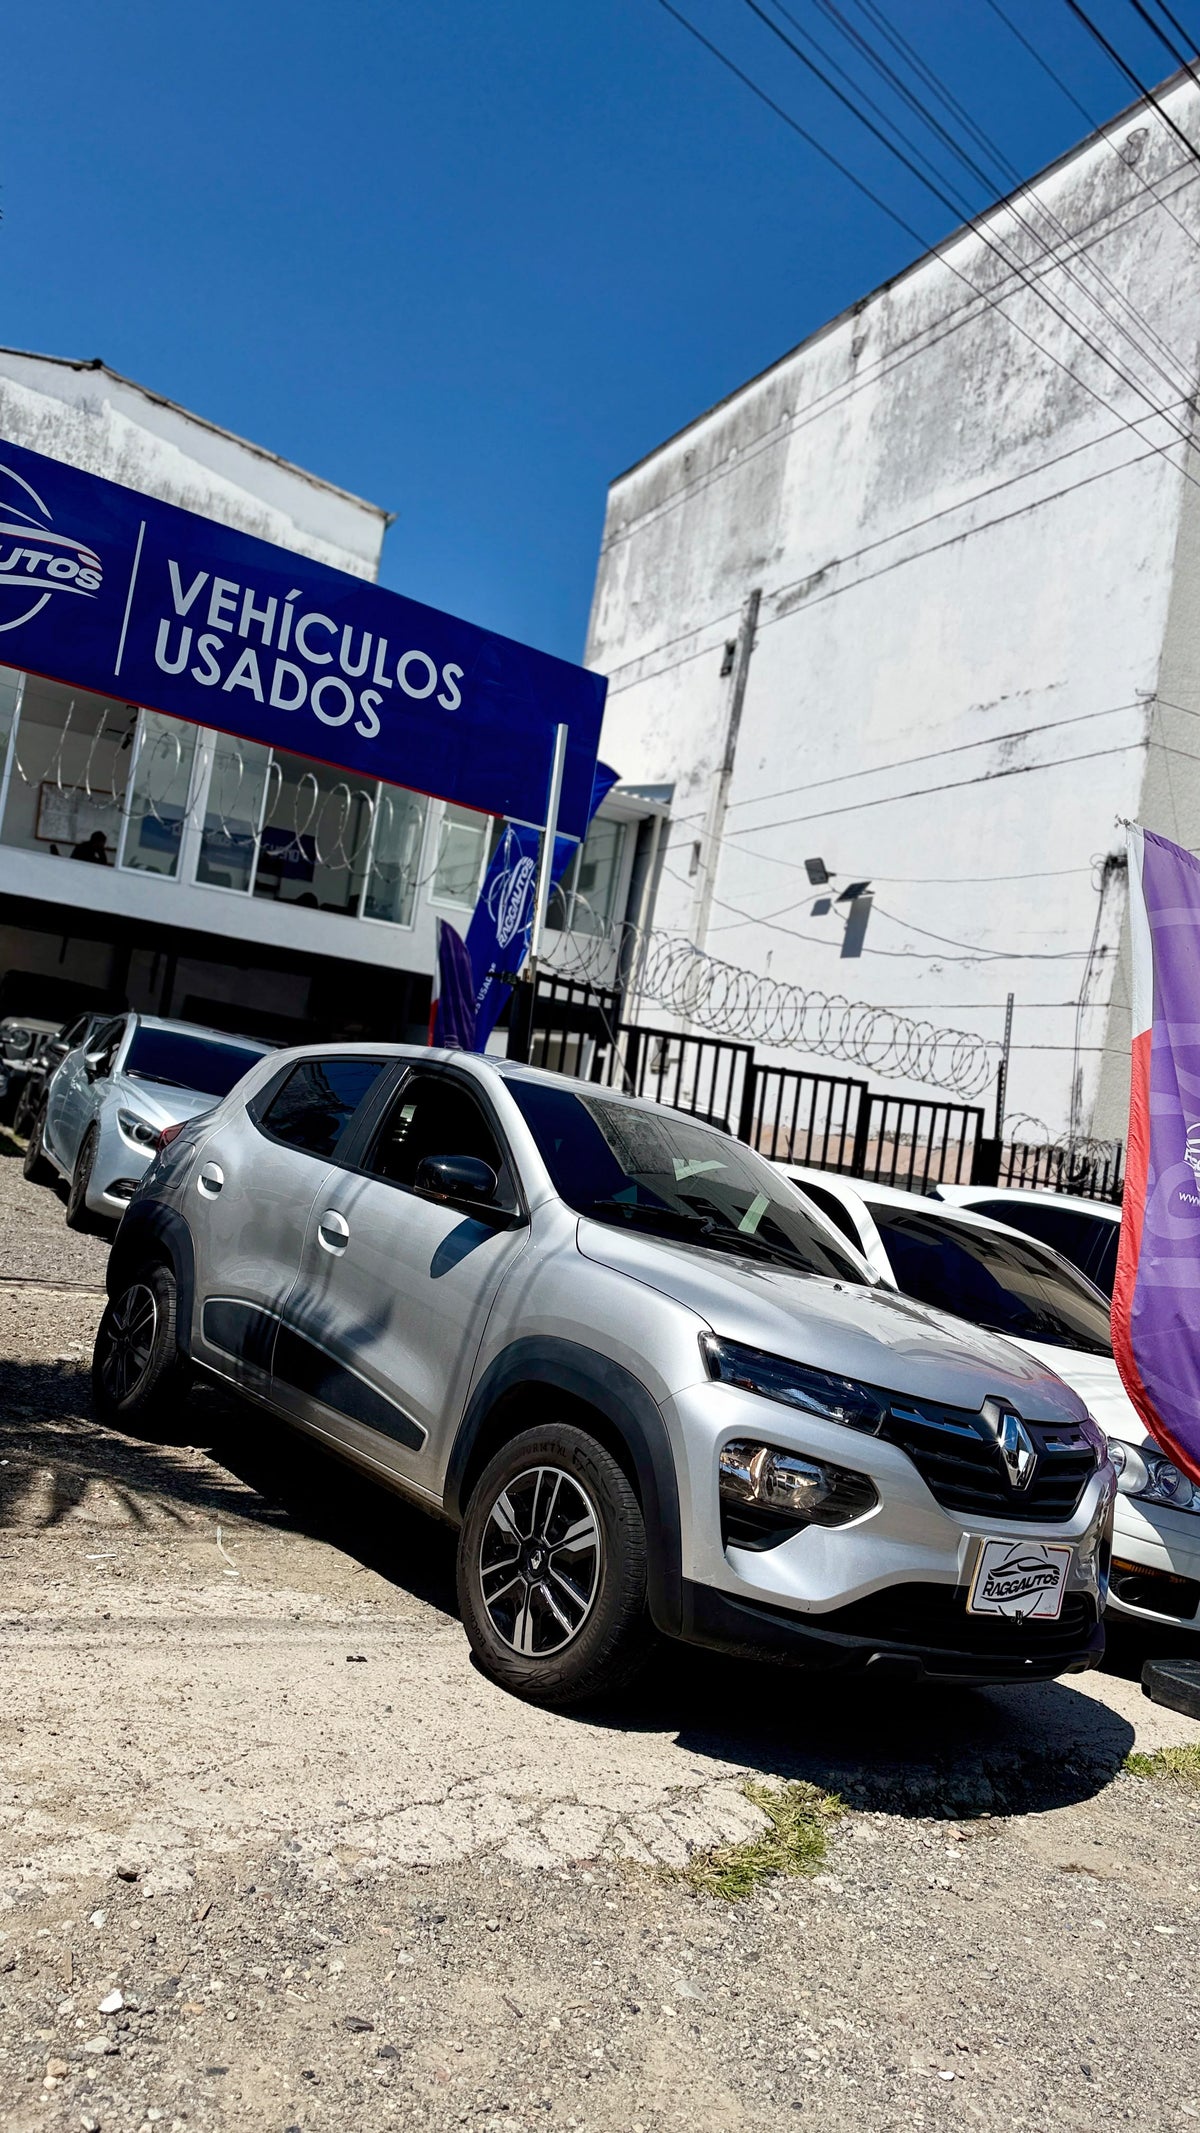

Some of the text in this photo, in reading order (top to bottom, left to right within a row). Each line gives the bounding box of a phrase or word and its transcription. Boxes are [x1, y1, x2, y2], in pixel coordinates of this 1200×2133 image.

[154, 618, 383, 739] USADOS
[168, 559, 465, 711] VEHÍCULOS
[499, 858, 534, 948] RAGGAUTOS
[983, 1573, 1060, 1597] RAGGAUTOS
